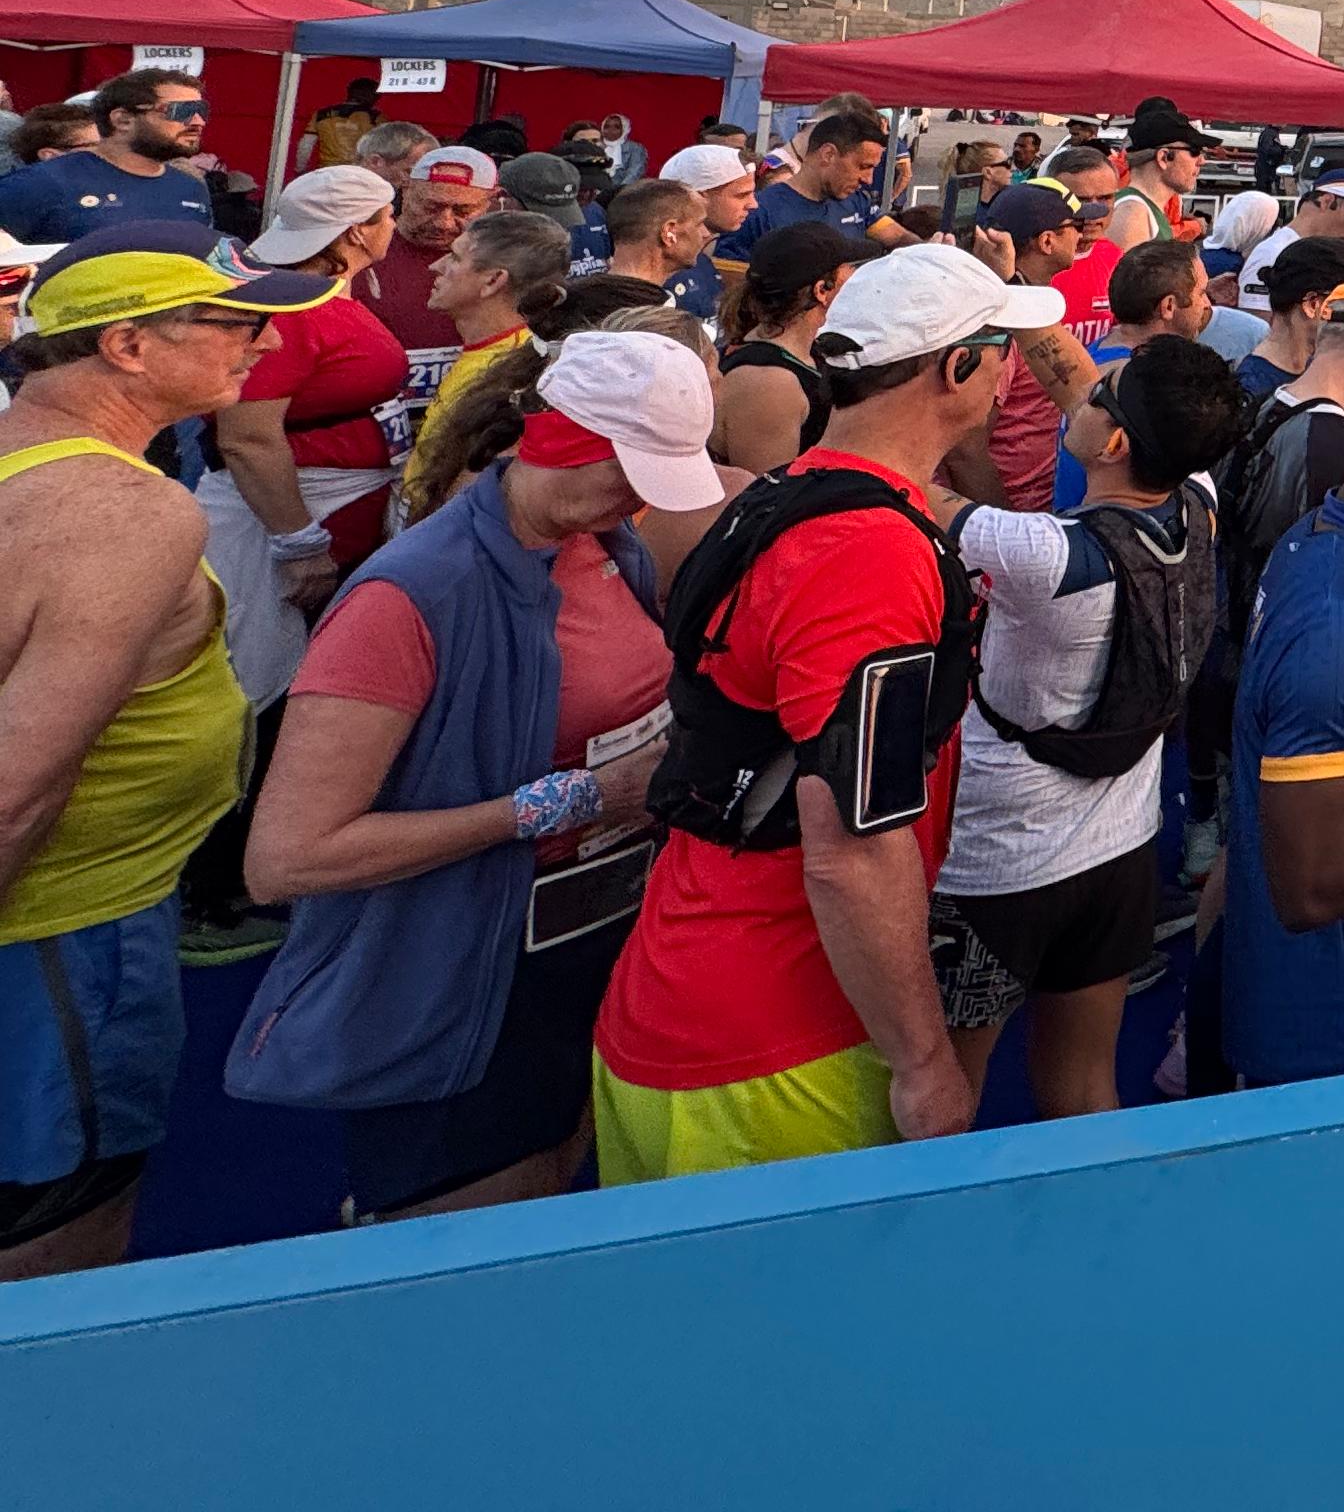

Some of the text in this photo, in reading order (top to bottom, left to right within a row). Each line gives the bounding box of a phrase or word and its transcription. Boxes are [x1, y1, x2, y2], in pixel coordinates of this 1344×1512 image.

[144, 47, 192, 58] LOCKERS
[391, 61, 436, 71] LOCKERS
[737, 768, 754, 786] 12
